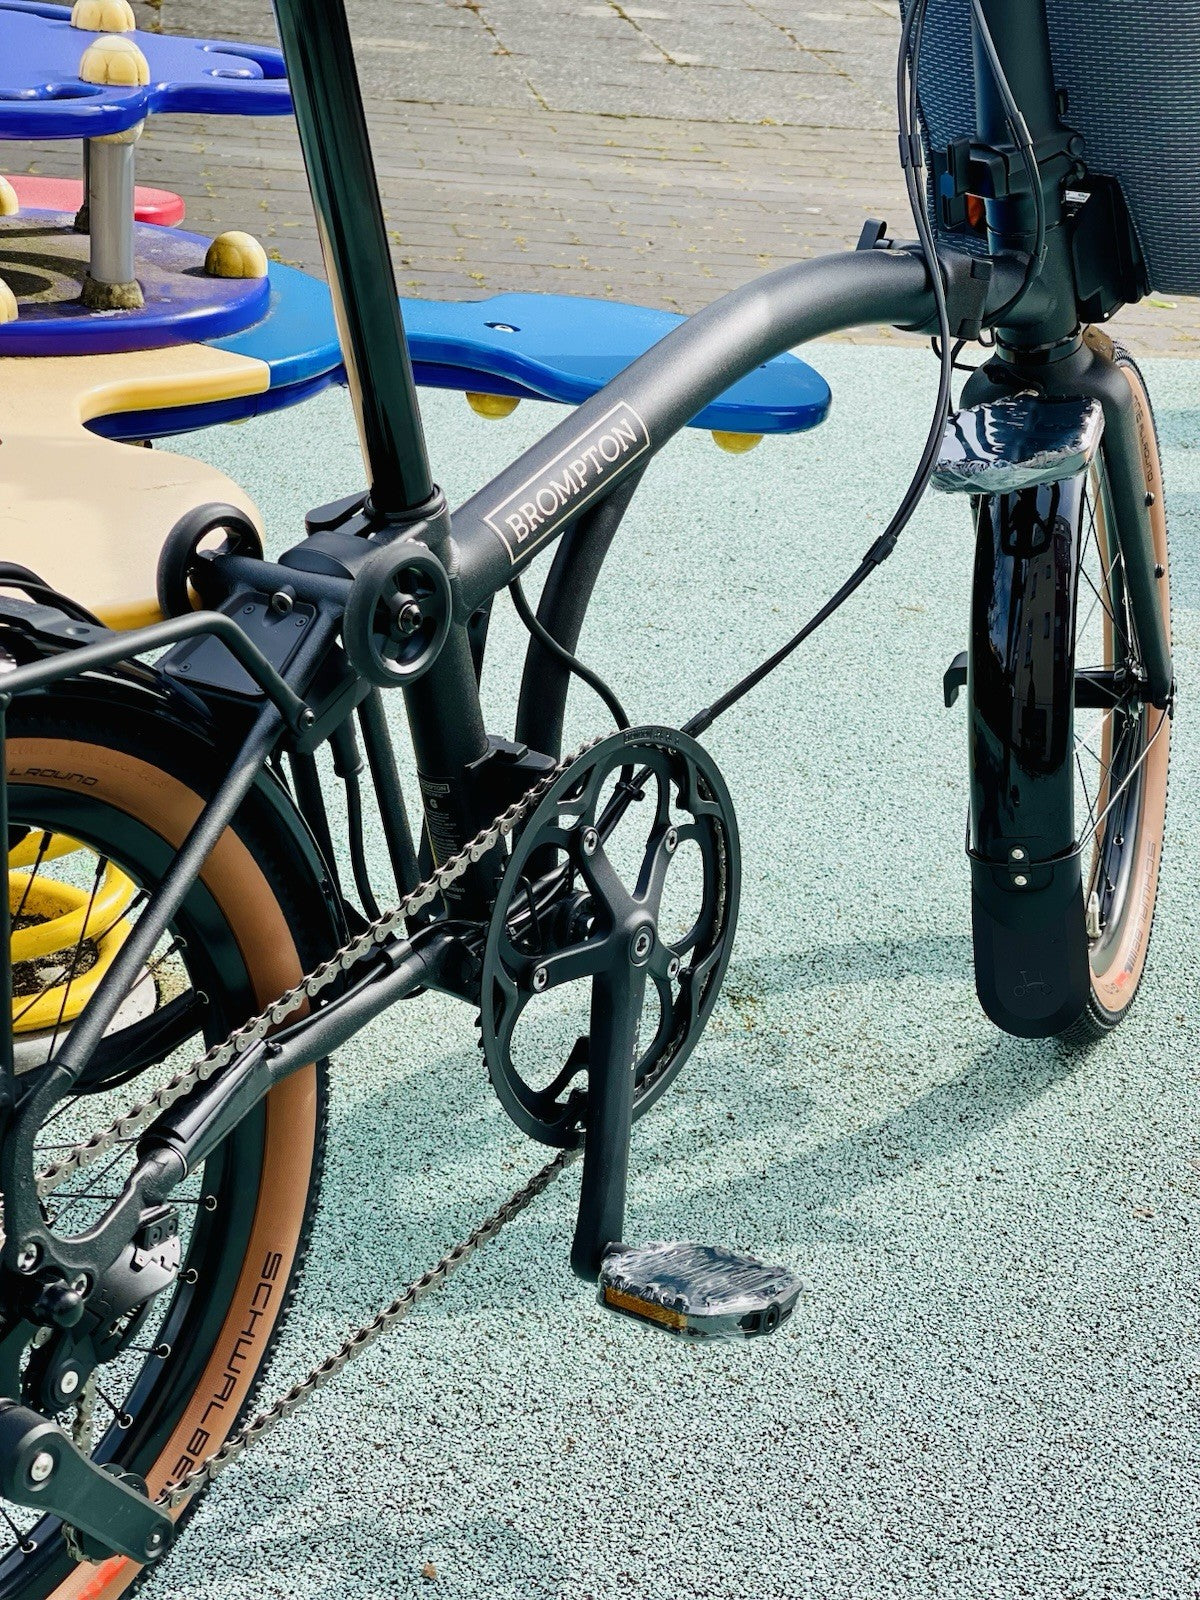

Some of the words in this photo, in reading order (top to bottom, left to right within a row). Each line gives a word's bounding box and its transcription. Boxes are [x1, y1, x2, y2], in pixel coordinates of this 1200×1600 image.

[504, 418, 638, 544] BROMPTON
[1139, 423, 1154, 482] ALLROUND
[8, 767, 99, 786] LROUND
[171, 1251, 283, 1480] SCHWALBE
